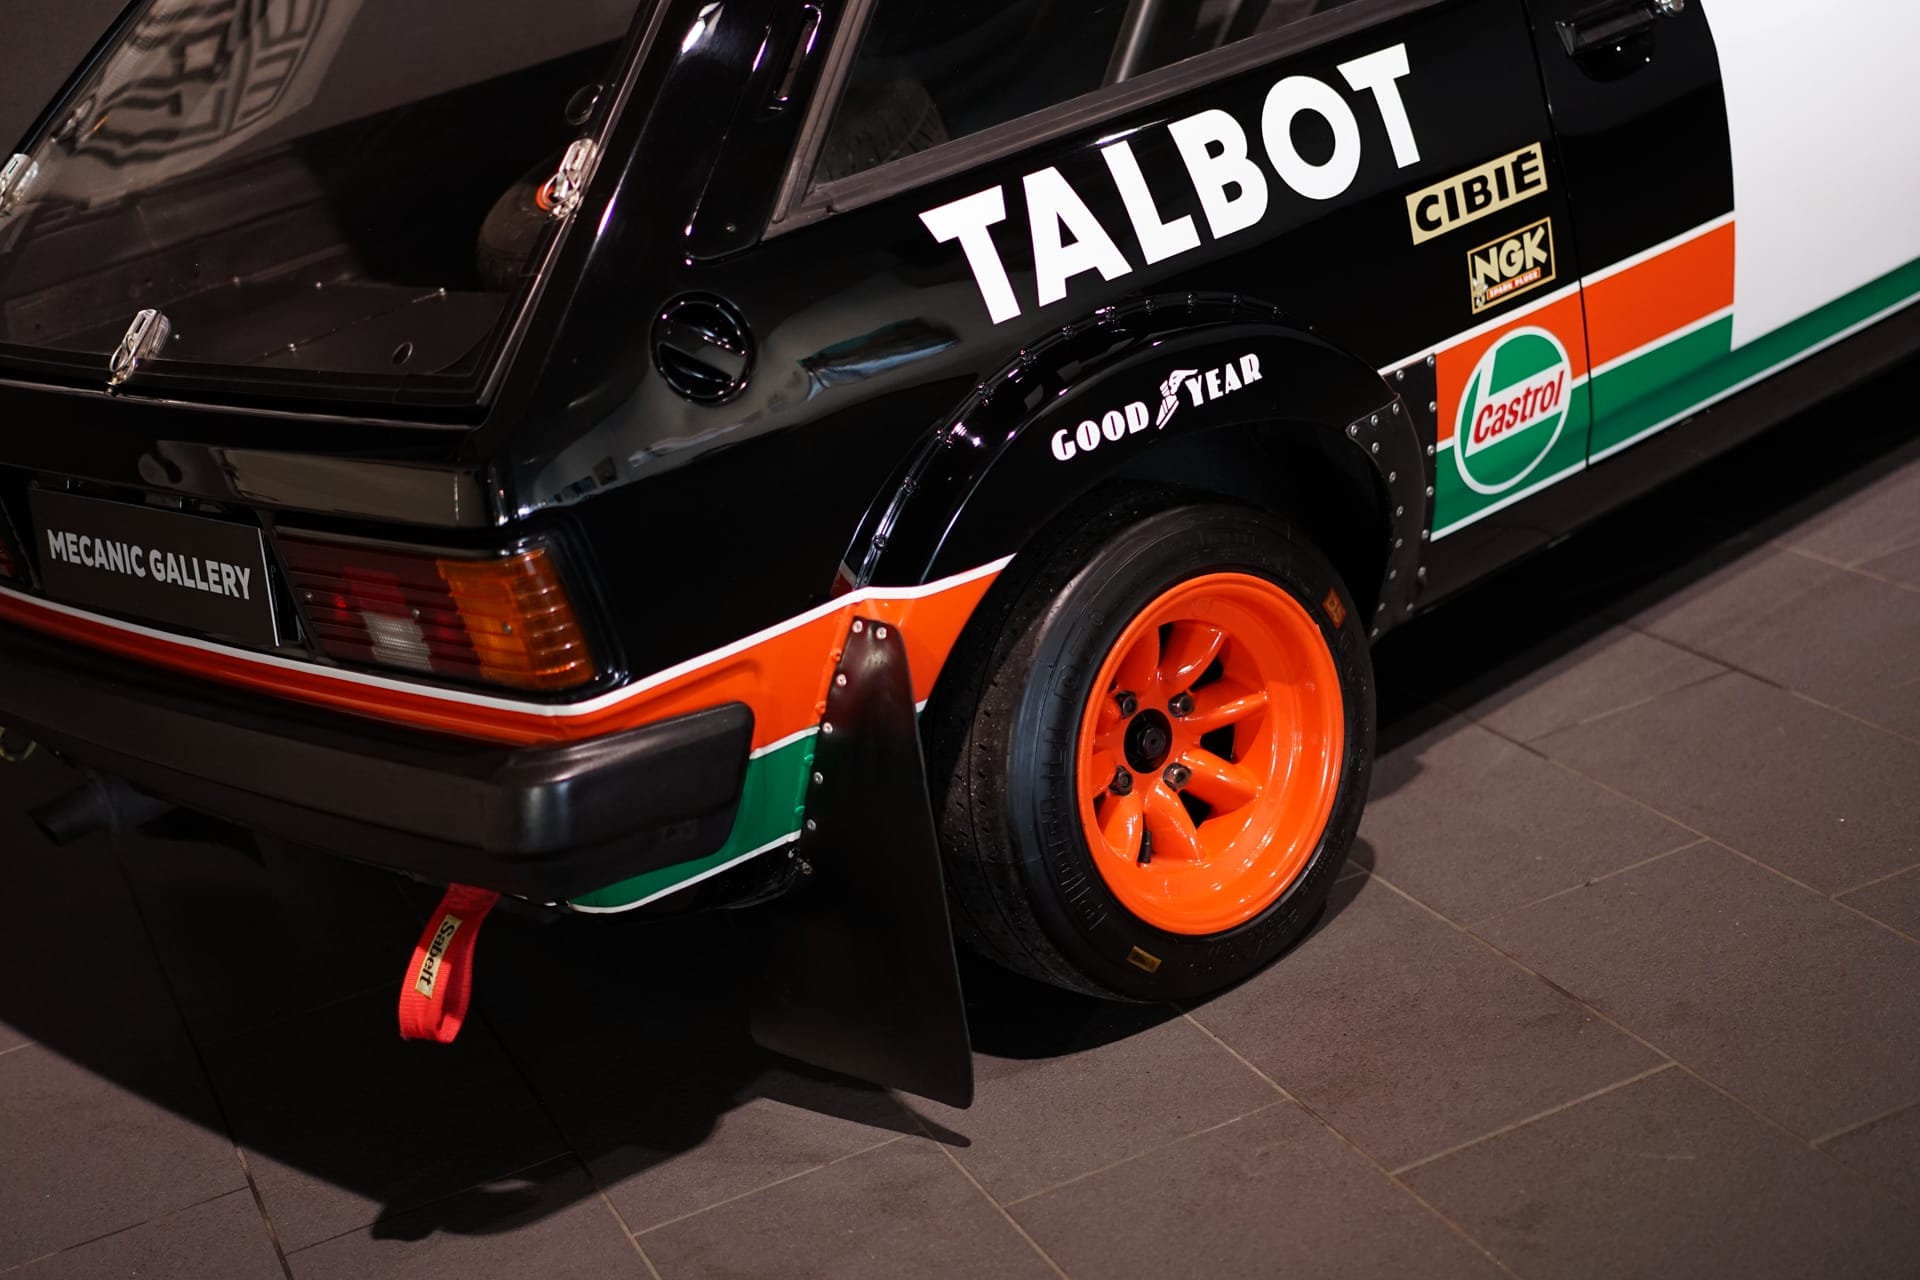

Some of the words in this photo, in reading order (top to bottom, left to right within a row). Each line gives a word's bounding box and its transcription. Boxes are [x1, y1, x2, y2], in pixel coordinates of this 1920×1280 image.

[919, 43, 1420, 325] TALBOT
[1474, 228, 1548, 284] NGK
[1489, 281, 1513, 298] SPARK
[1514, 270, 1540, 286] PLUGS
[1051, 401, 1149, 461] GOOD
[1184, 353, 1263, 407] YEAR
[1474, 370, 1565, 443] Castrol
[47, 529, 146, 578] MECANIC
[149, 549, 251, 600] GALLERY
[419, 921, 455, 987] Sabelt
